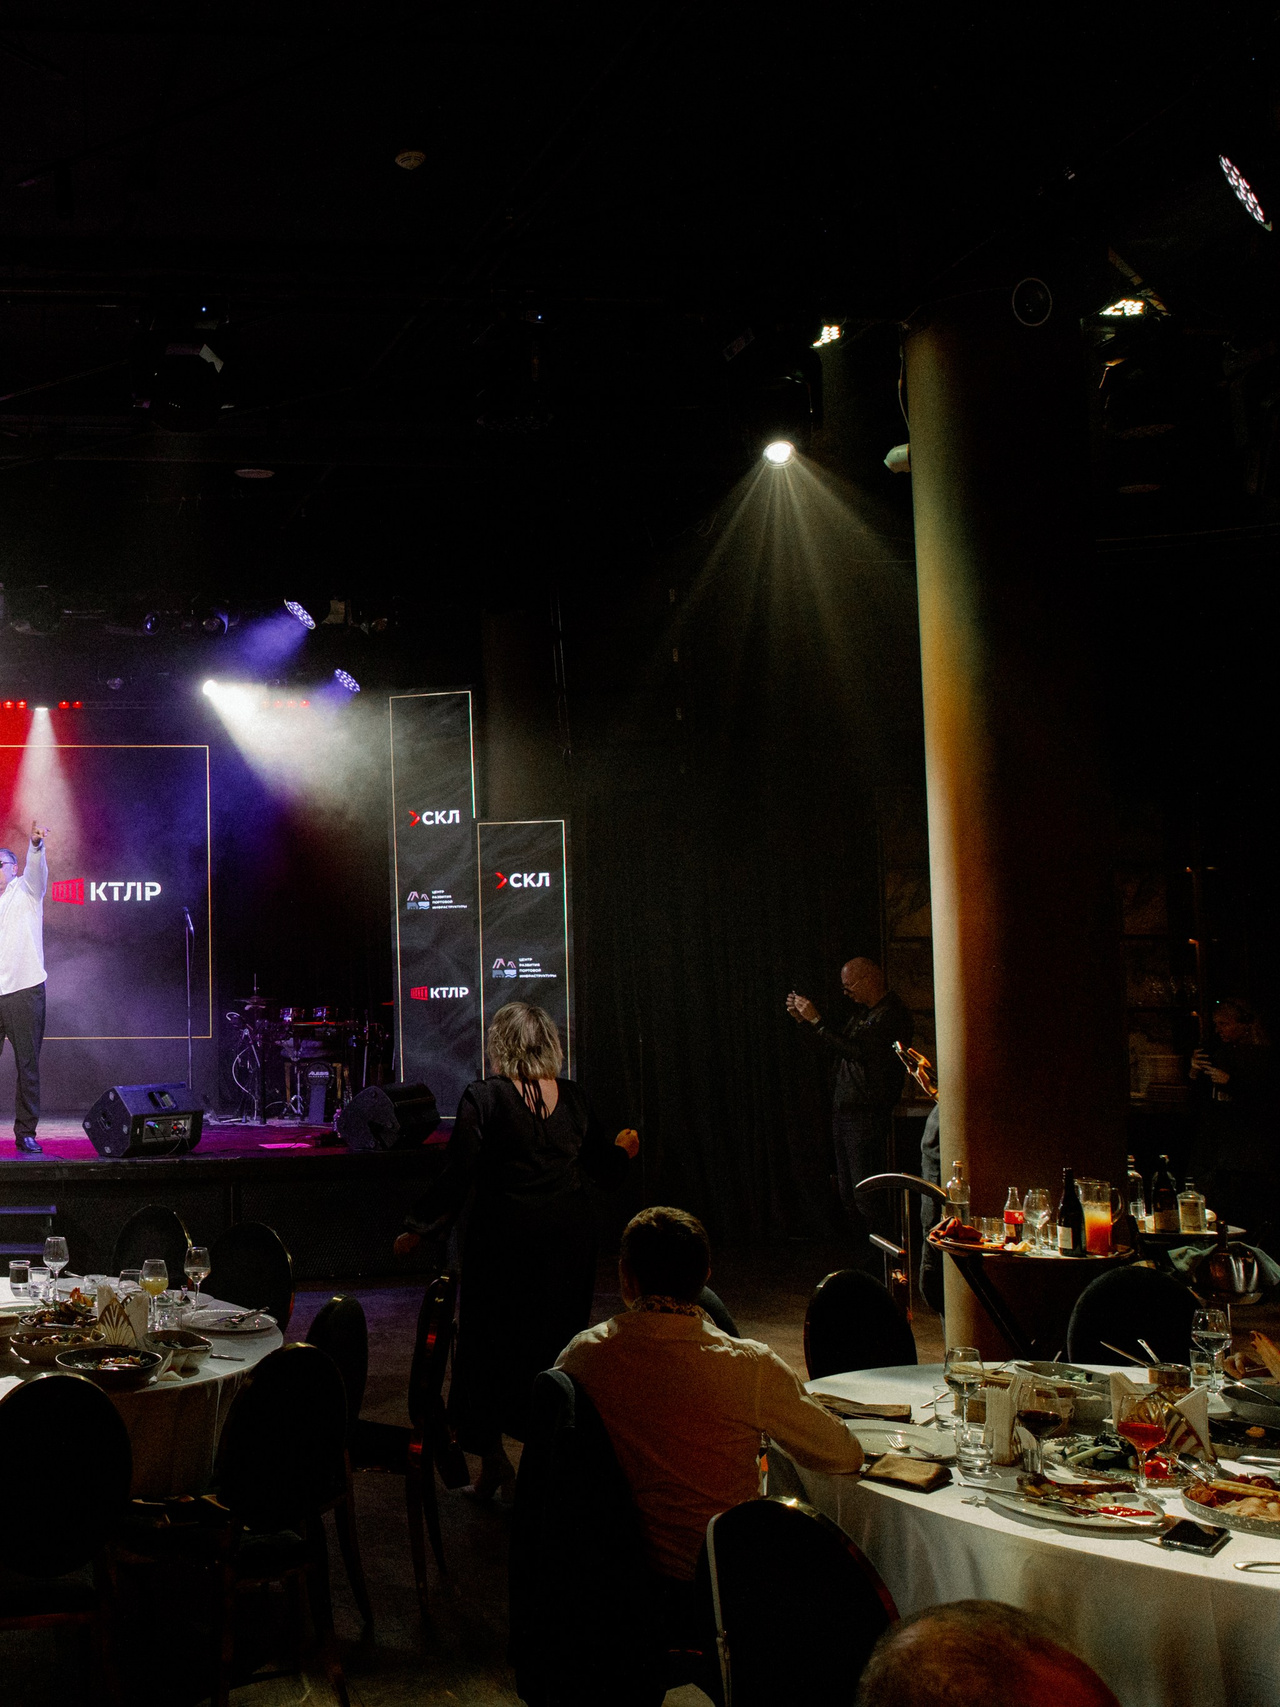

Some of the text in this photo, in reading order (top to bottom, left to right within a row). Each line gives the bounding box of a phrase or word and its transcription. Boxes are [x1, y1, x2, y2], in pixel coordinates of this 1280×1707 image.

[422, 809, 460, 825] СКЛ
[510, 873, 550, 888] СКЛ
[90, 881, 162, 902] КТЛР
[430, 986, 470, 999] КТЛР
